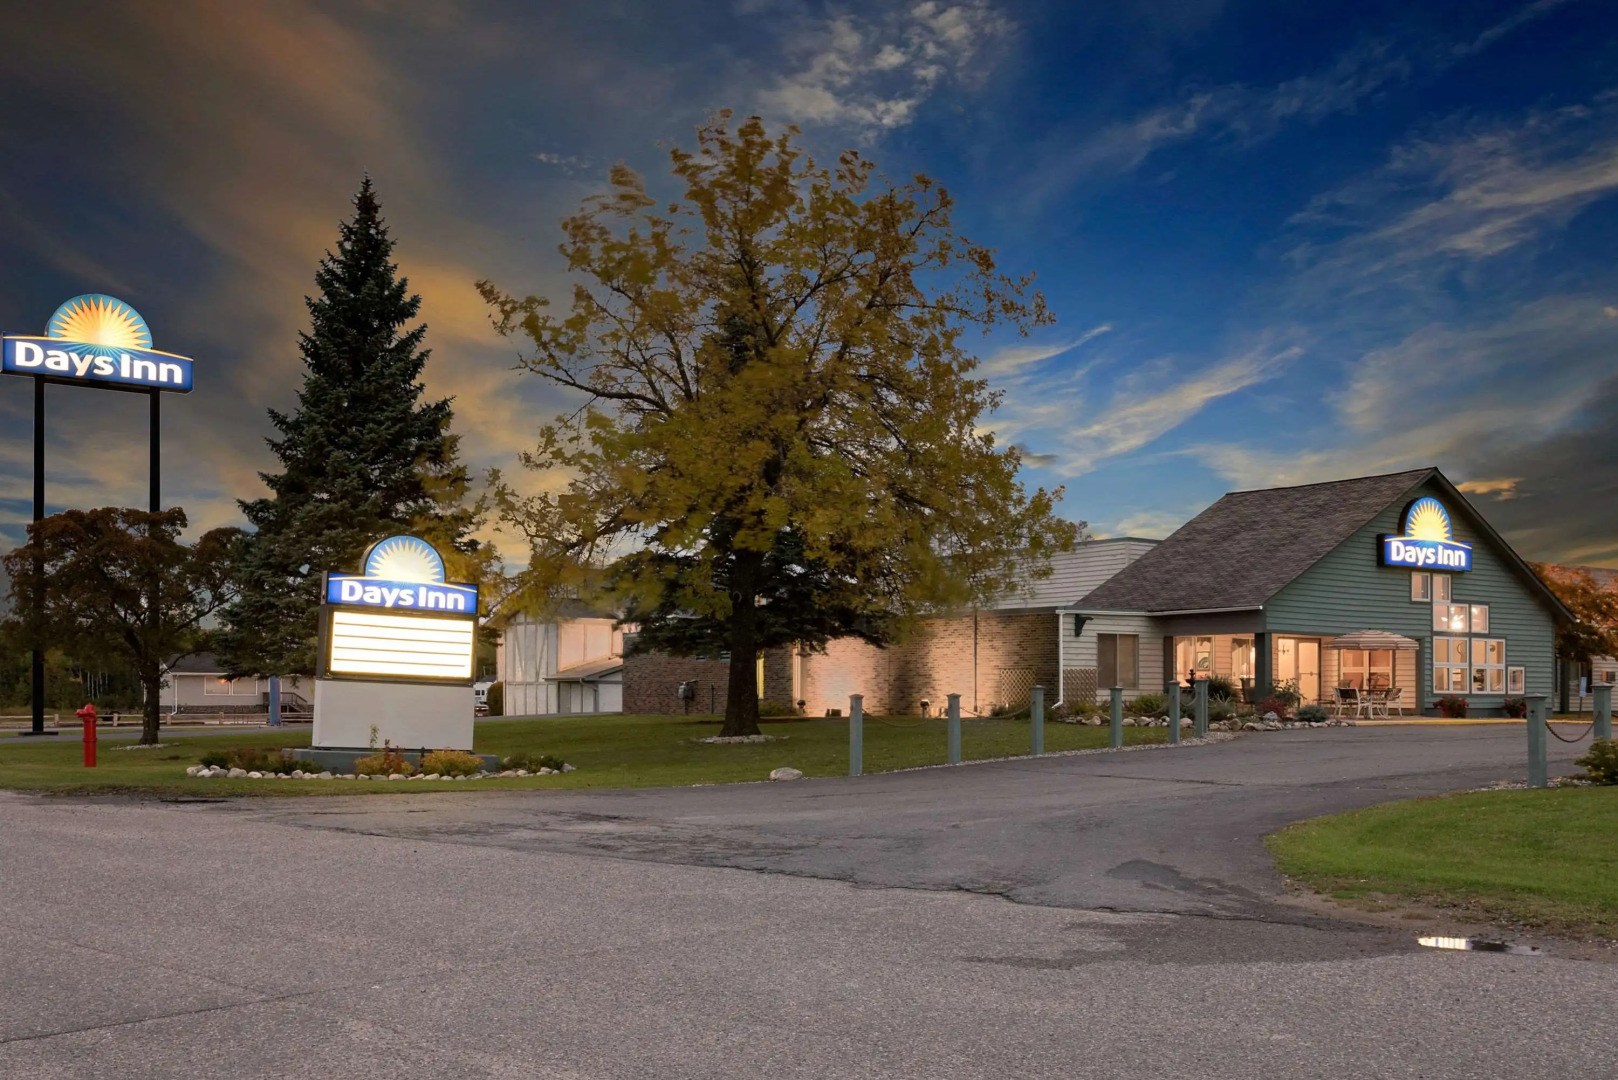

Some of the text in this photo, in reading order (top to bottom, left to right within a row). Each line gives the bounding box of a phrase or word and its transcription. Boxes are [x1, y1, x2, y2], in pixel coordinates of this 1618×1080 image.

[15, 341, 183, 384] Days Inn
[1391, 541, 1466, 567] Days Inn
[341, 580, 465, 610] Days Inn
